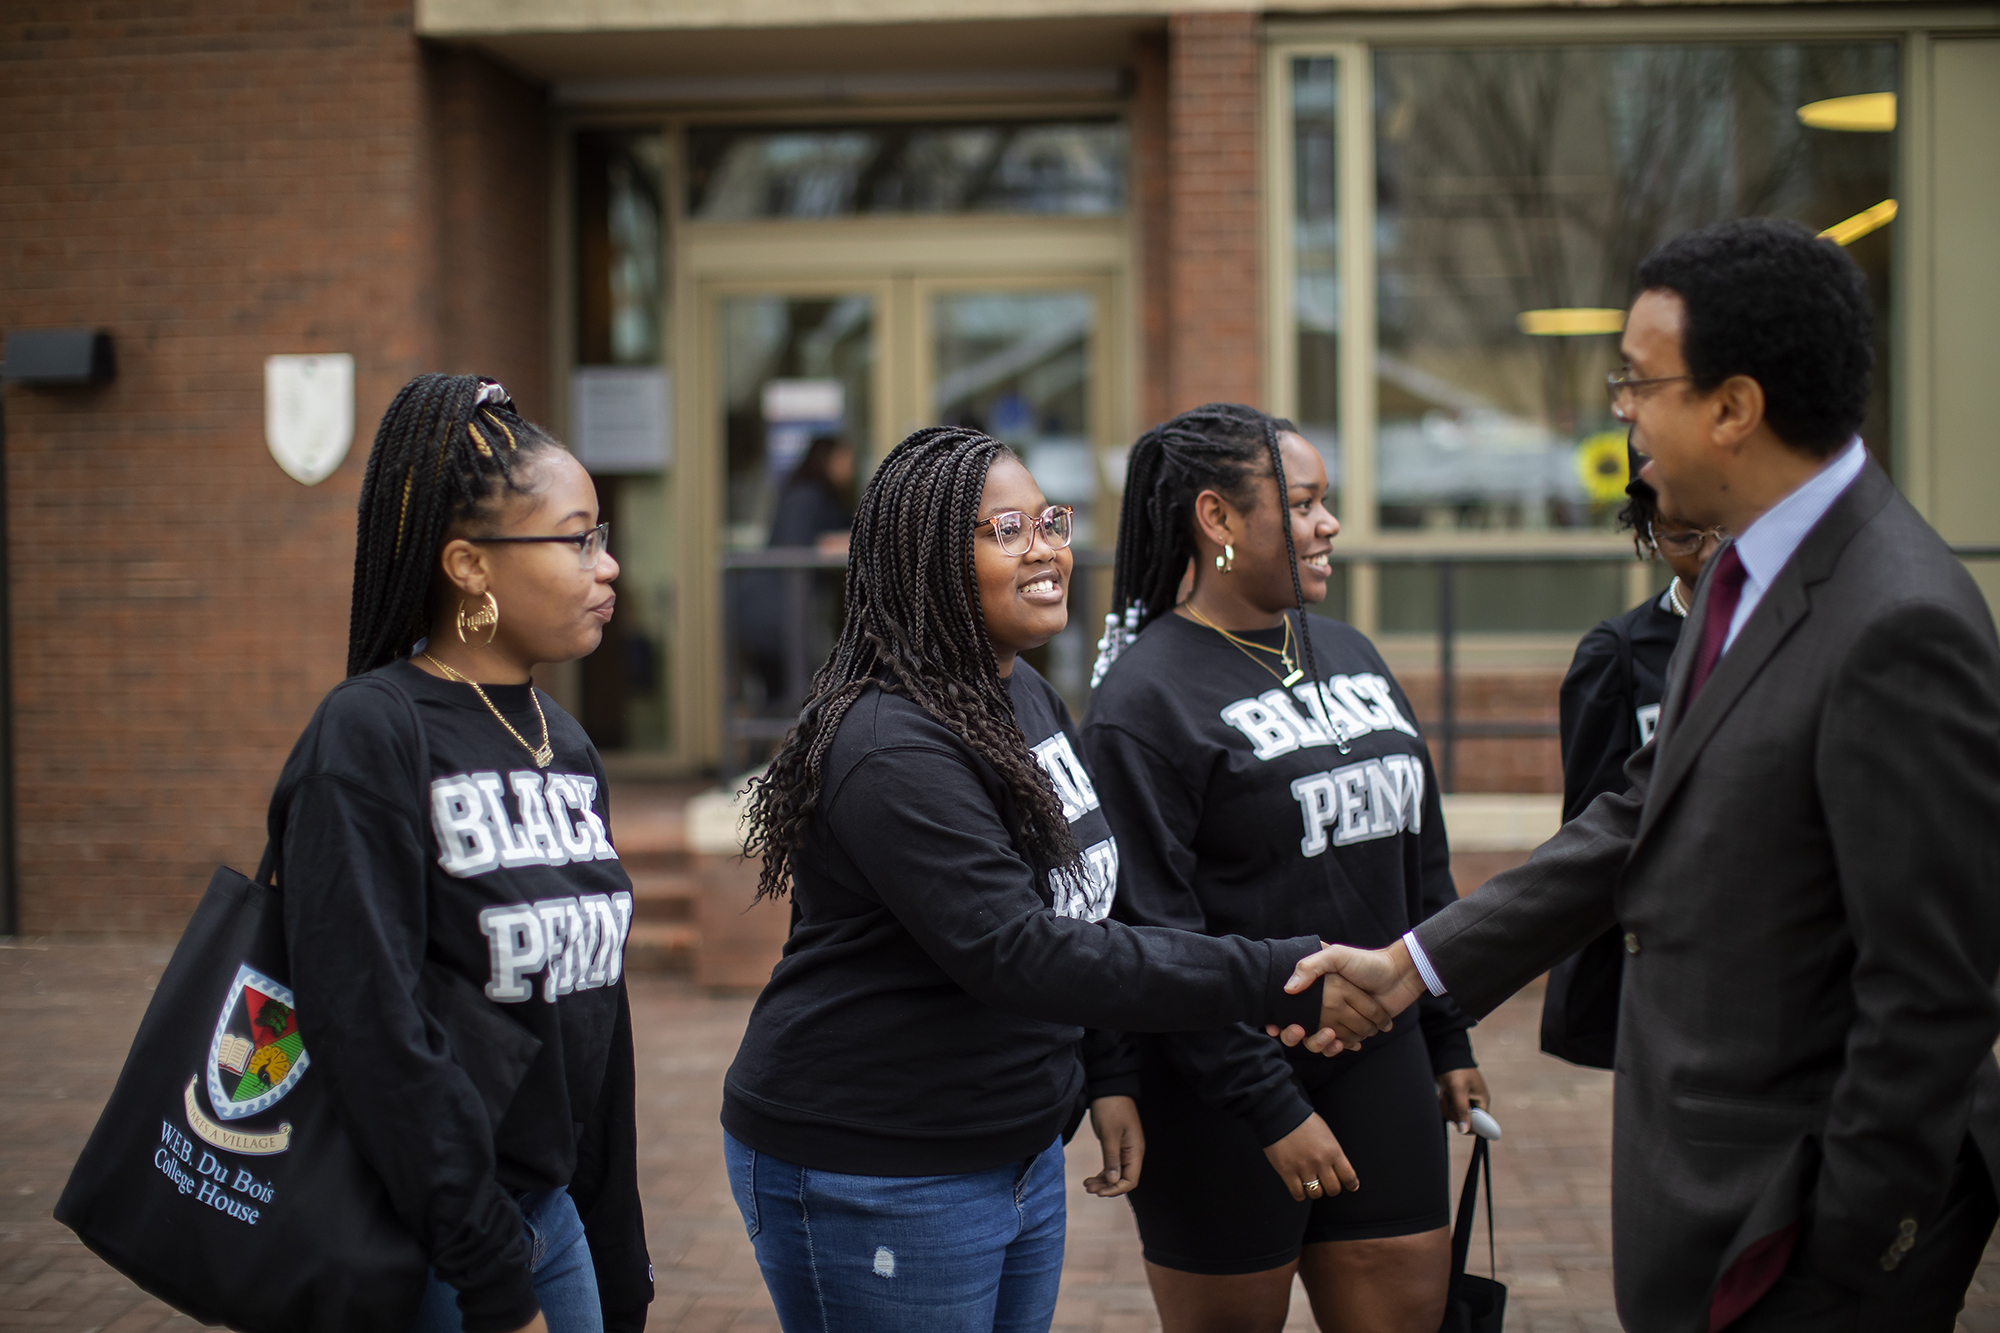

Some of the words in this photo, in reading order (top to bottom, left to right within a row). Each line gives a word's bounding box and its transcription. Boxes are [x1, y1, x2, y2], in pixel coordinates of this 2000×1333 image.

[1220, 673, 1418, 761] BLACK
[431, 771, 619, 878] BLACK
[1290, 754, 1425, 858] PENN
[478, 891, 633, 1003] PENN
[161, 1120, 193, 1167] W.E.B.
[196, 1152, 228, 1183] Du
[230, 1169, 275, 1204] Bois
[189, 1104, 210, 1134] TAKES
[208, 1129, 218, 1141] A
[223, 1132, 276, 1149] VILLAGE
[154, 1148, 195, 1195] College
[195, 1180, 260, 1225] House
